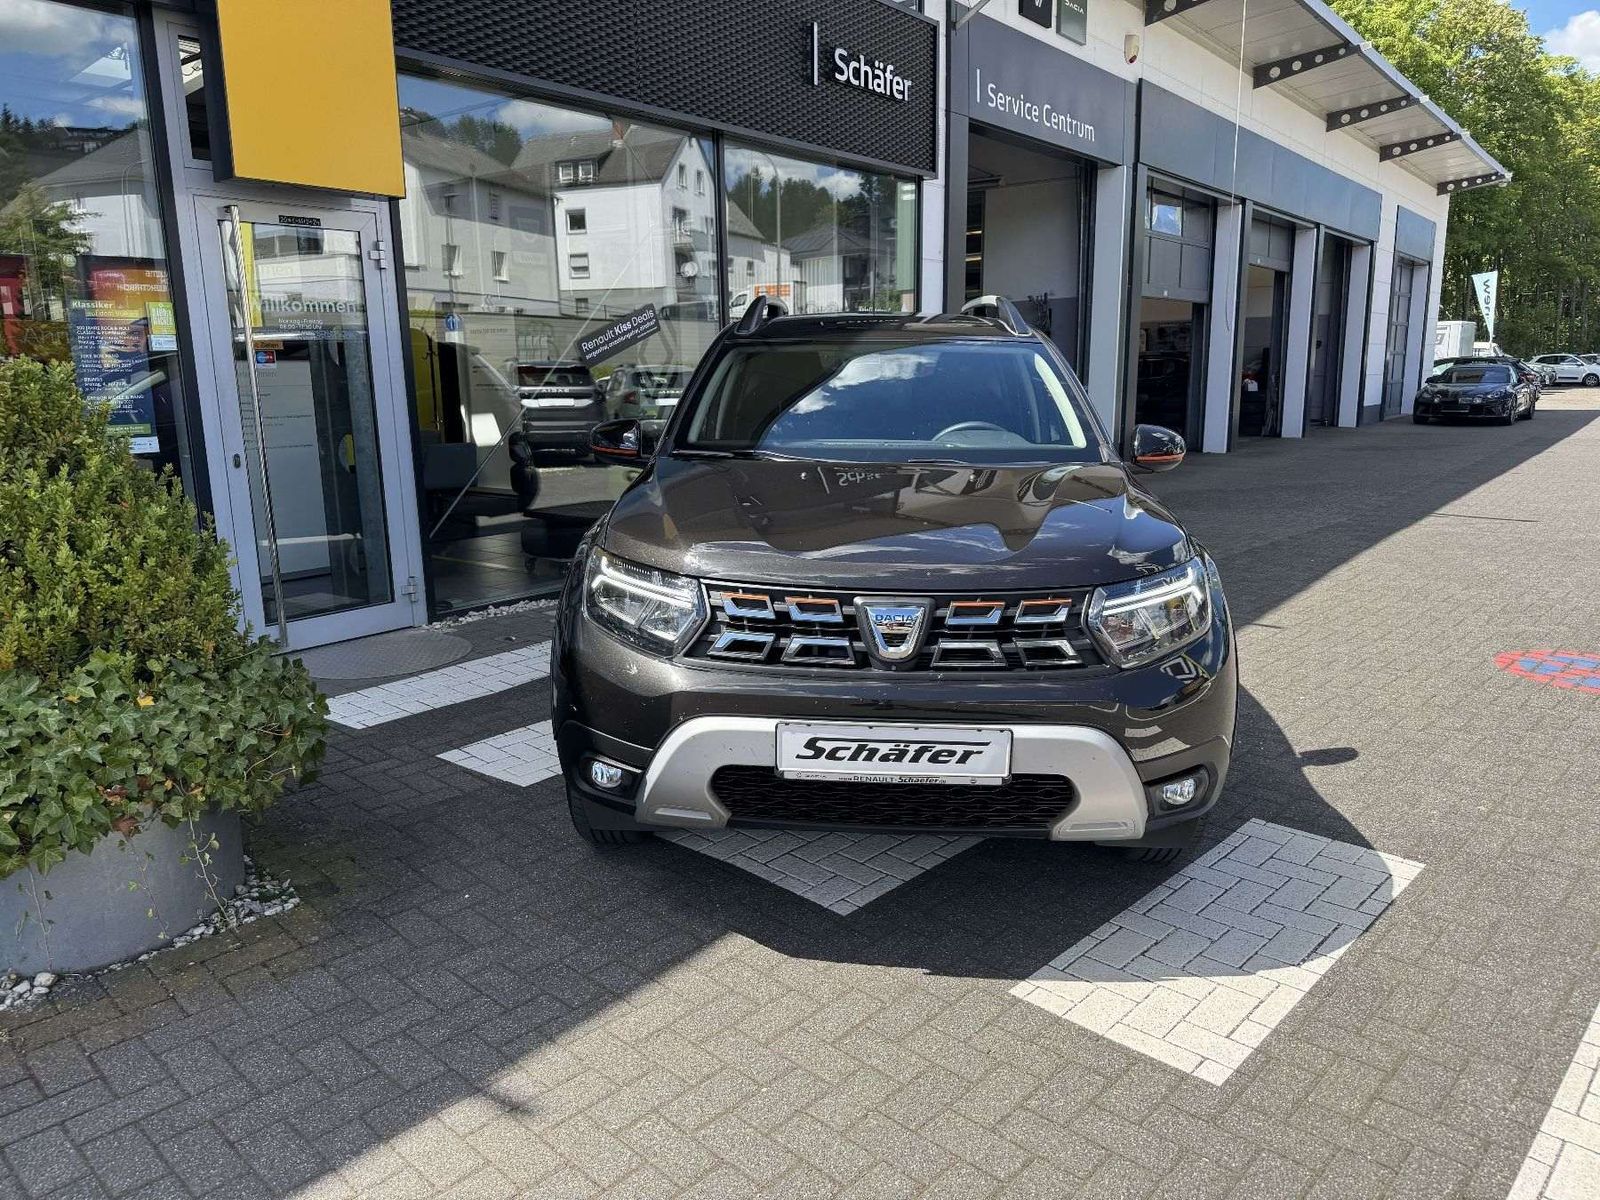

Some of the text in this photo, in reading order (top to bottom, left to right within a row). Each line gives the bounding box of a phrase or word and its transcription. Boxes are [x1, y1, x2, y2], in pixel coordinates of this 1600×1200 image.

[834, 48, 912, 101] Schäfer
[987, 83, 1095, 142] Service Centrum
[72, 300, 113, 309] Klassiker
[581, 329, 615, 352] Renault
[614, 321, 632, 336] Kiss
[631, 309, 655, 327] Deals
[875, 613, 916, 623] DACIA
[795, 736, 992, 765] Schäfer
